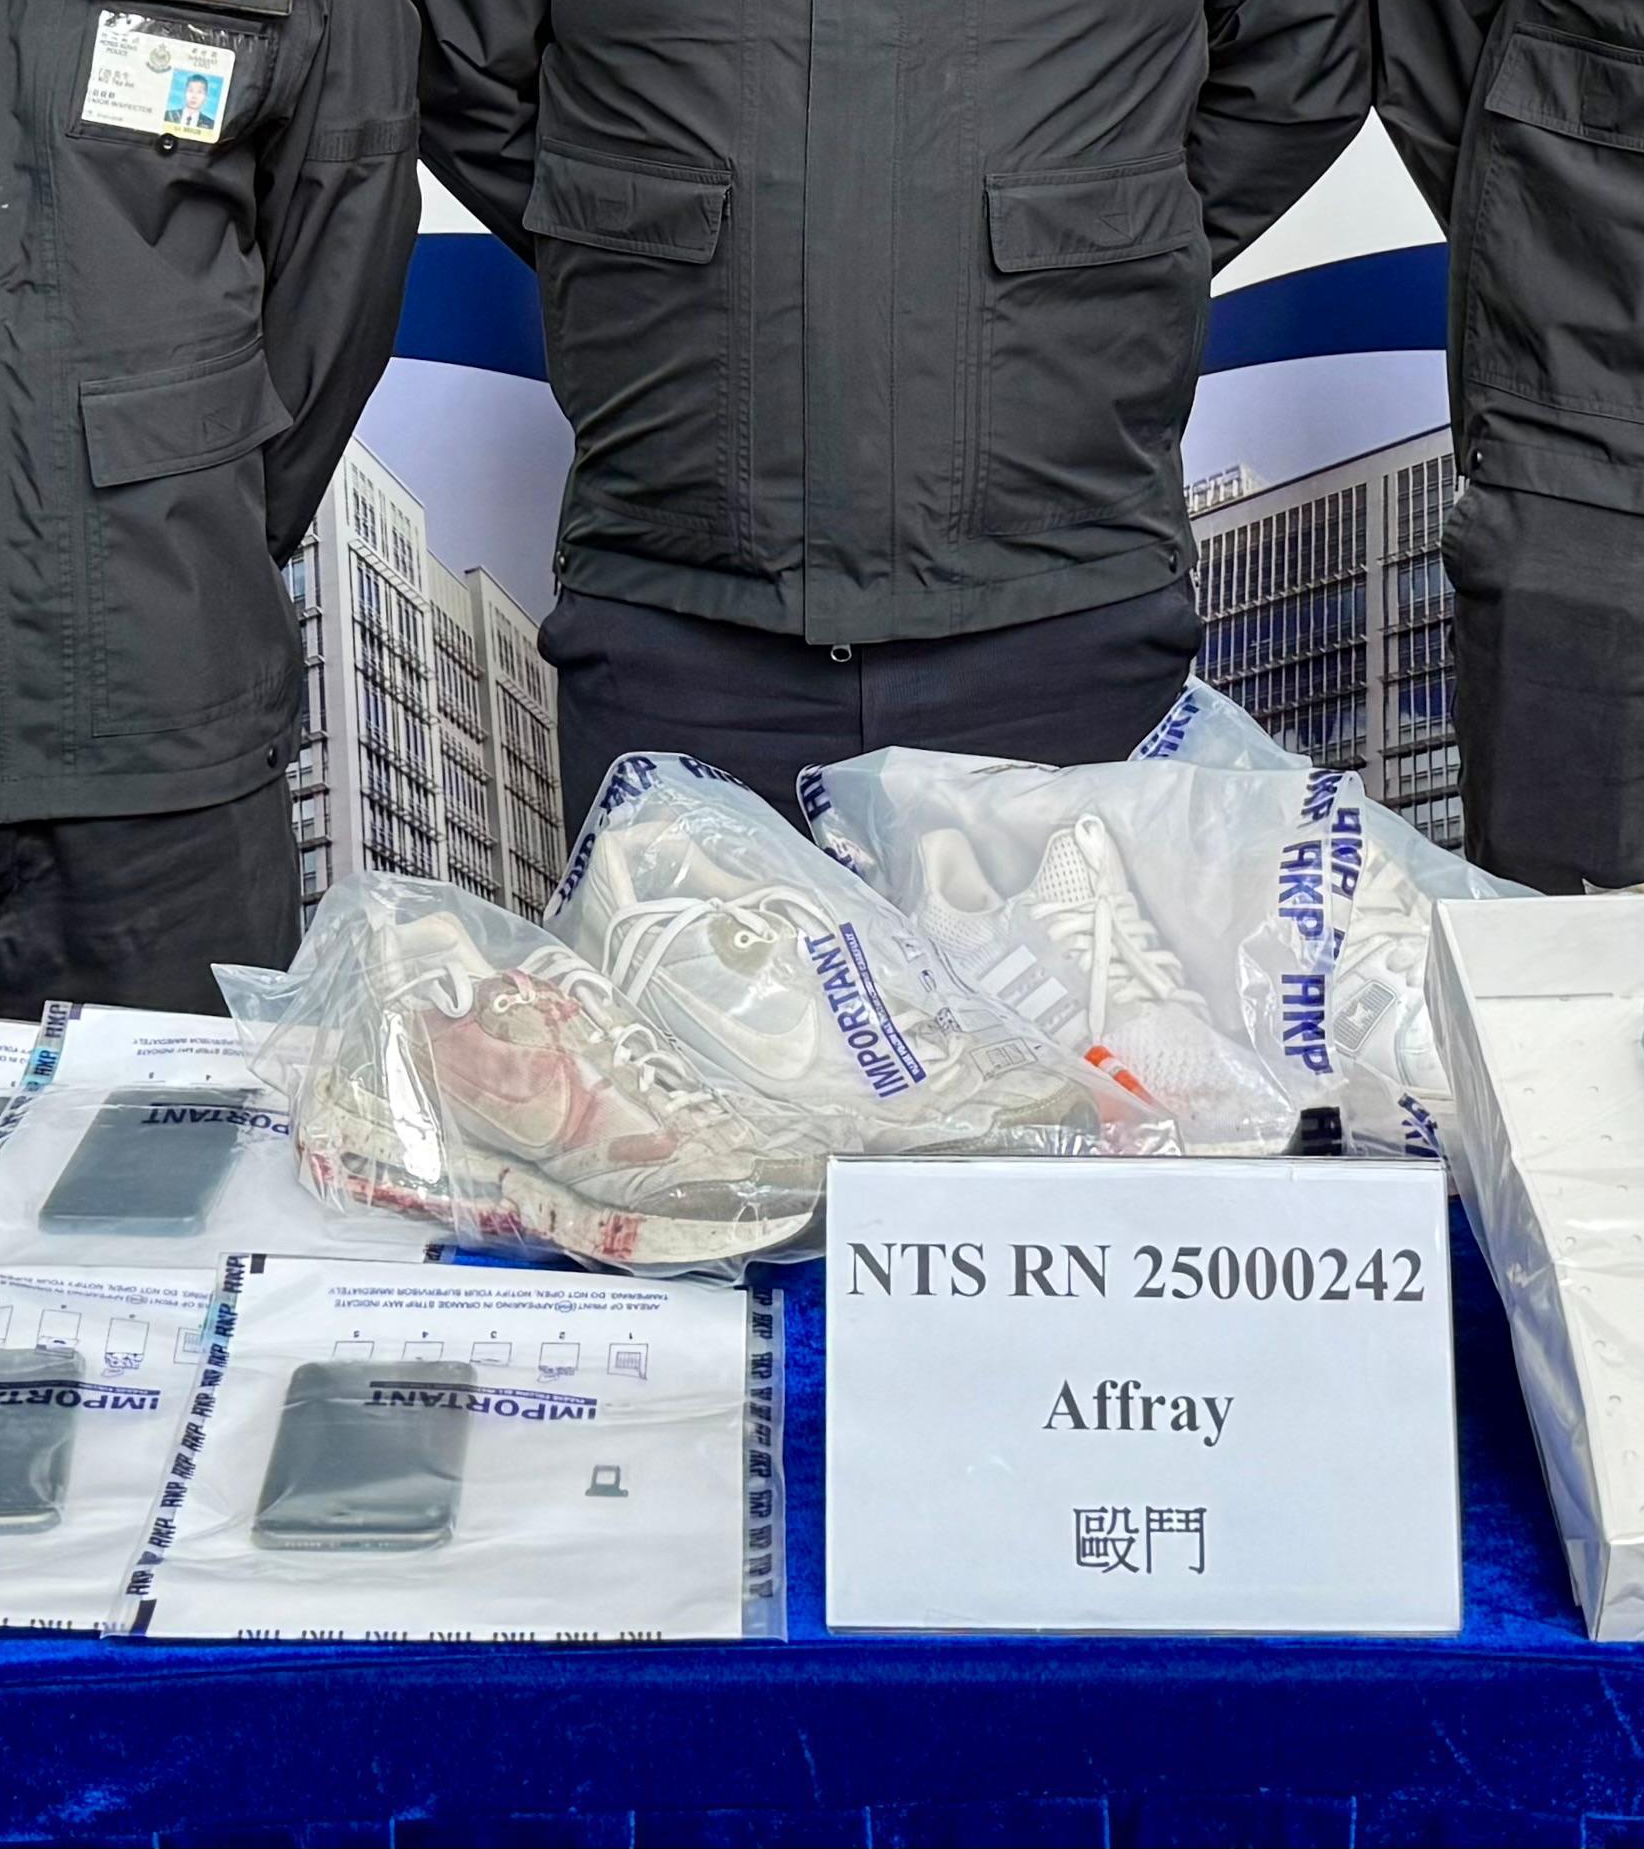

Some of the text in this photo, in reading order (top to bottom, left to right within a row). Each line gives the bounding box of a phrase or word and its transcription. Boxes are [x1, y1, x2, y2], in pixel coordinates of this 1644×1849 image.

[1331, 807, 1363, 900] HKP
[1279, 840, 1326, 941] HKP
[805, 932, 909, 1098] IMPORTANT
[1281, 974, 1334, 1075] HKP
[848, 1243, 1424, 1301] NTS RN 25000242
[327, 1286, 395, 1297] IMMEDIATELY
[397, 1287, 461, 1297] SUPERVISOR
[464, 1288, 493, 1297] YOUR
[496, 1289, 532, 1298] NOTIFY
[567, 1290, 589, 1298] NOT
[591, 1290, 606, 1299] DO
[334, 1298, 380, 1308] INDICATE
[382, 1300, 403, 1308] MAY
[404, 1300, 435, 1309] STRIP
[438, 1300, 481, 1309] ORANGE
[482, 1301, 493, 1309] IN
[610, 1302, 624, 1311] OF
[625, 1302, 660, 1311] AREAS
[366, 1389, 597, 1423] IMPORTANT
[1043, 1380, 1233, 1447] Affray
[1073, 1506, 1207, 1574] 毆鬥
